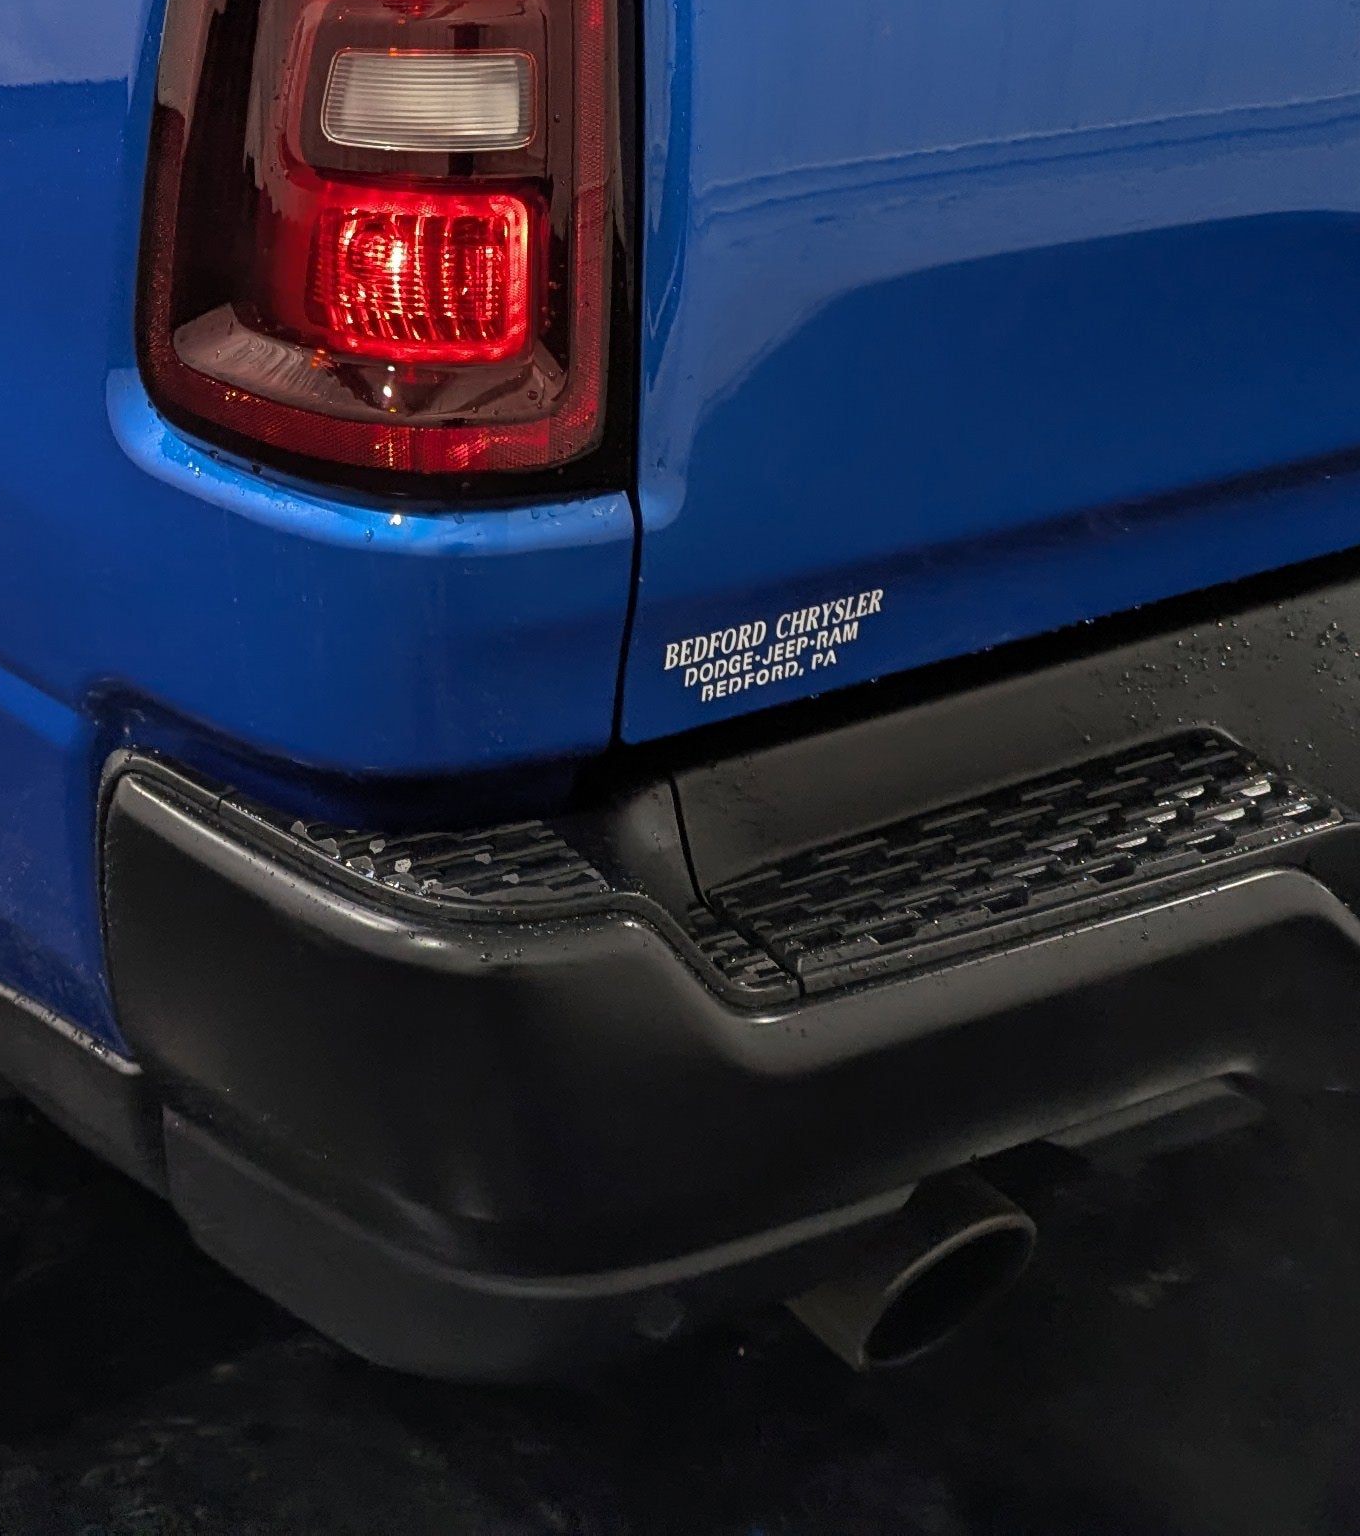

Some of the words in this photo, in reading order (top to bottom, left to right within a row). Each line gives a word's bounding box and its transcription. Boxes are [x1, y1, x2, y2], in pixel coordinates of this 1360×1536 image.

[663, 620, 767, 671] BEDFORD
[776, 588, 884, 640] CHRYSLER
[700, 661, 806, 703] BEDFORD,
[810, 650, 838, 671] PA
